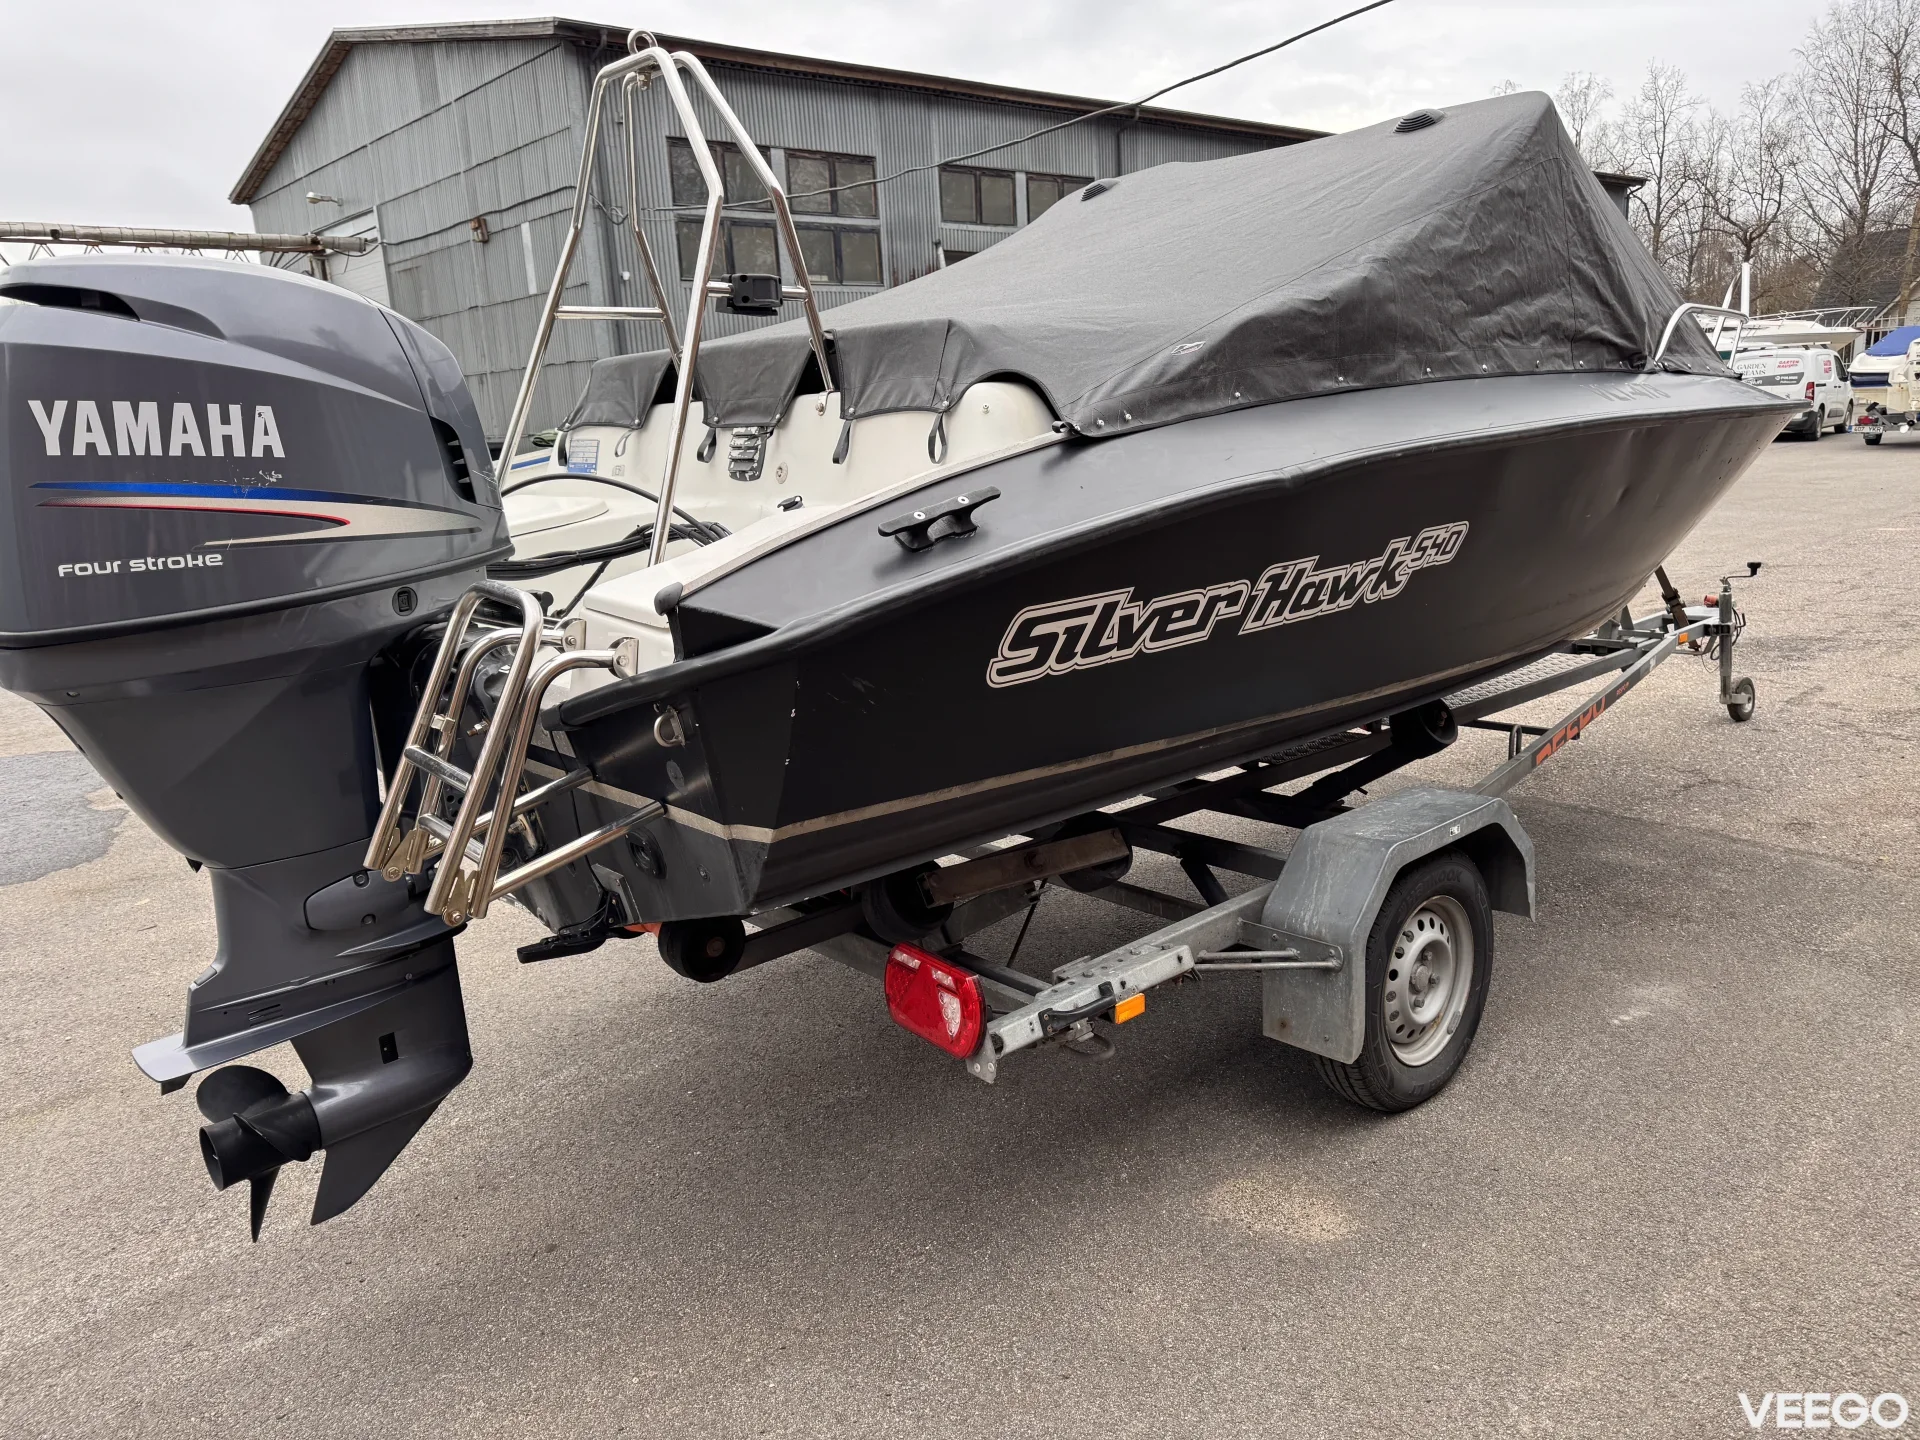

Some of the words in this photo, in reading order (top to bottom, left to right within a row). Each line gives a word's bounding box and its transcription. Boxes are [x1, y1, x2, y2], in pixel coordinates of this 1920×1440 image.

[1737, 363, 1767, 371] GARDEN
[28, 399, 286, 458] YAMAHA
[1238, 536, 1415, 636] Hawk
